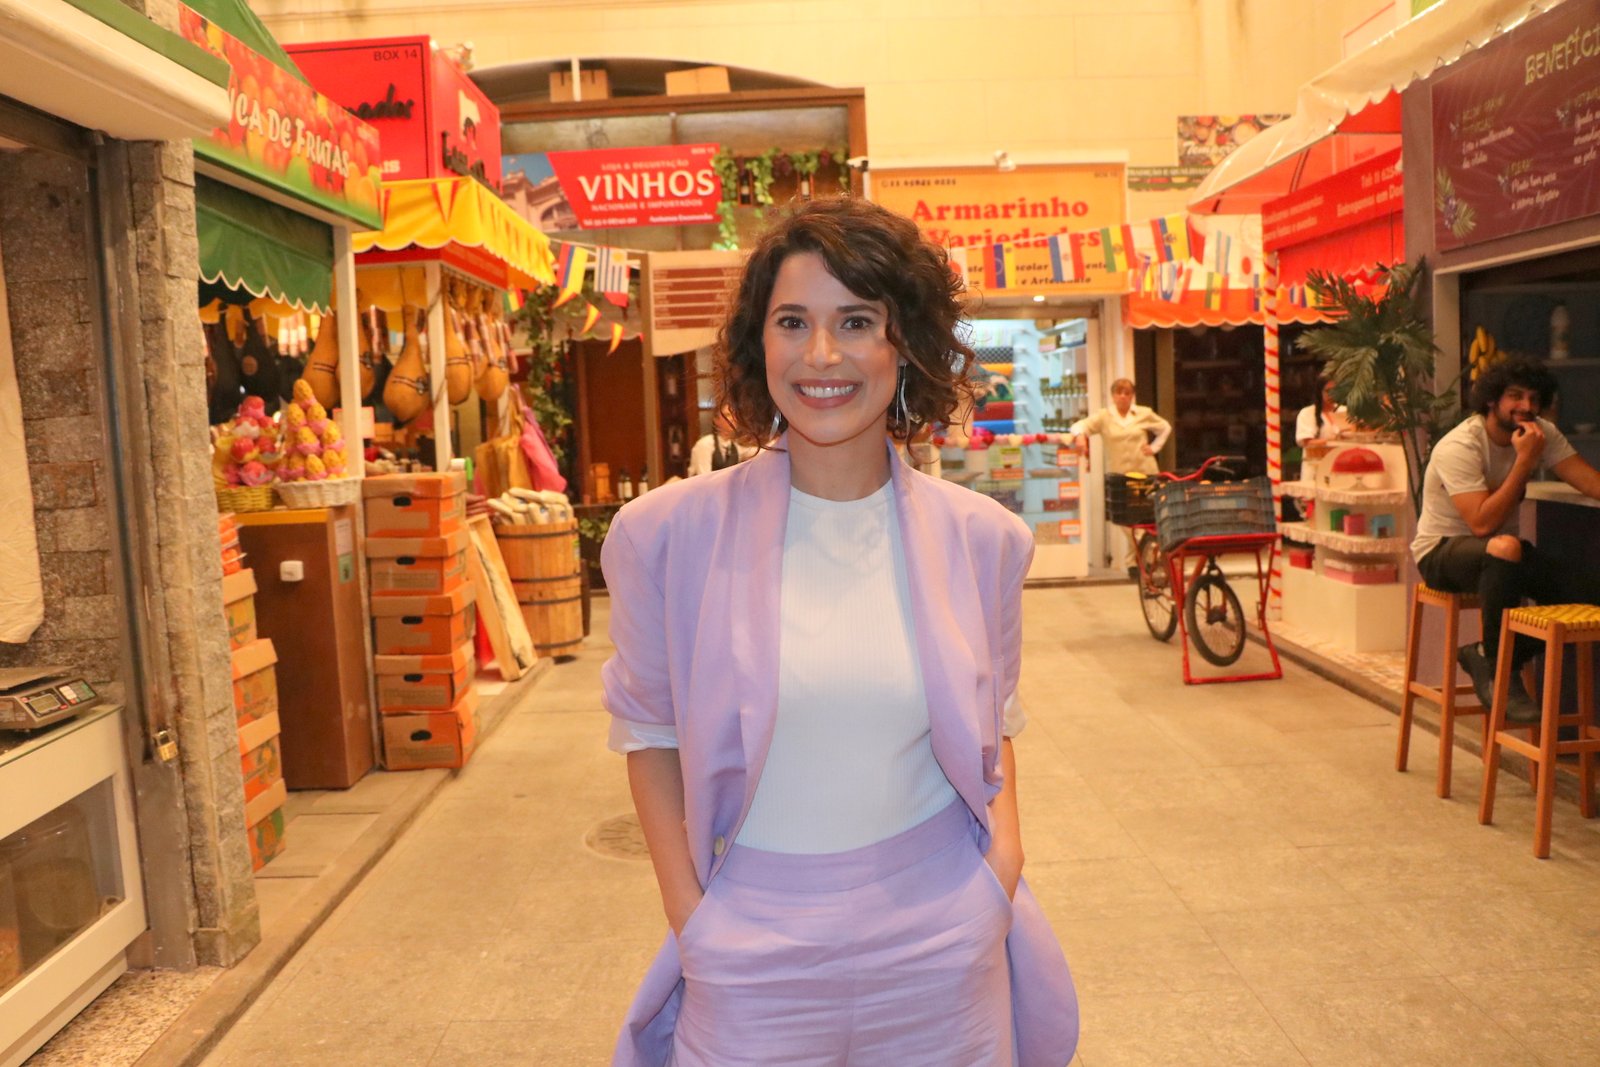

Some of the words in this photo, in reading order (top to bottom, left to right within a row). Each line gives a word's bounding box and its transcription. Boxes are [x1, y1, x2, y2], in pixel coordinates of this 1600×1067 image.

[374, 51, 399, 61] BOX
[405, 49, 418, 59] 14
[296, 118, 349, 178] FRUTAS
[578, 169, 715, 202] VINHOS
[912, 197, 1089, 221] Armarinho
